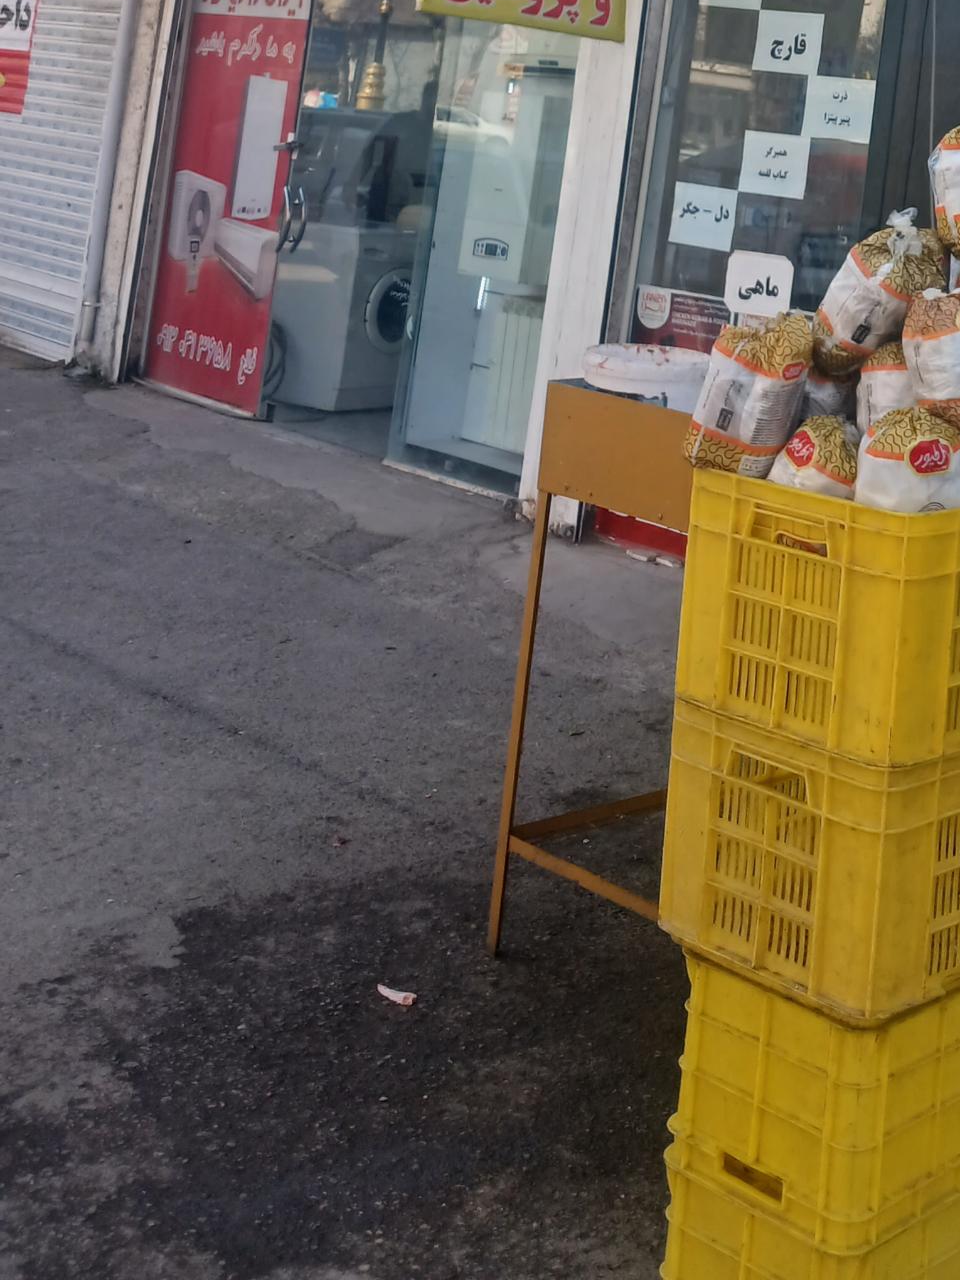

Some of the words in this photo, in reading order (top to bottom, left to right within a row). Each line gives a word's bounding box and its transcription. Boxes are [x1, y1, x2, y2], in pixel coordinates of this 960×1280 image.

[265, 35, 279, 58] ما
[282, 40, 297, 65] به
[770, 33, 807, 60] قارچ
[832, 90, 848, 104] ذرت
[678, 202, 700, 219] جگر
[713, 205, 730, 222] دل
[738, 275, 780, 300] ماهی
